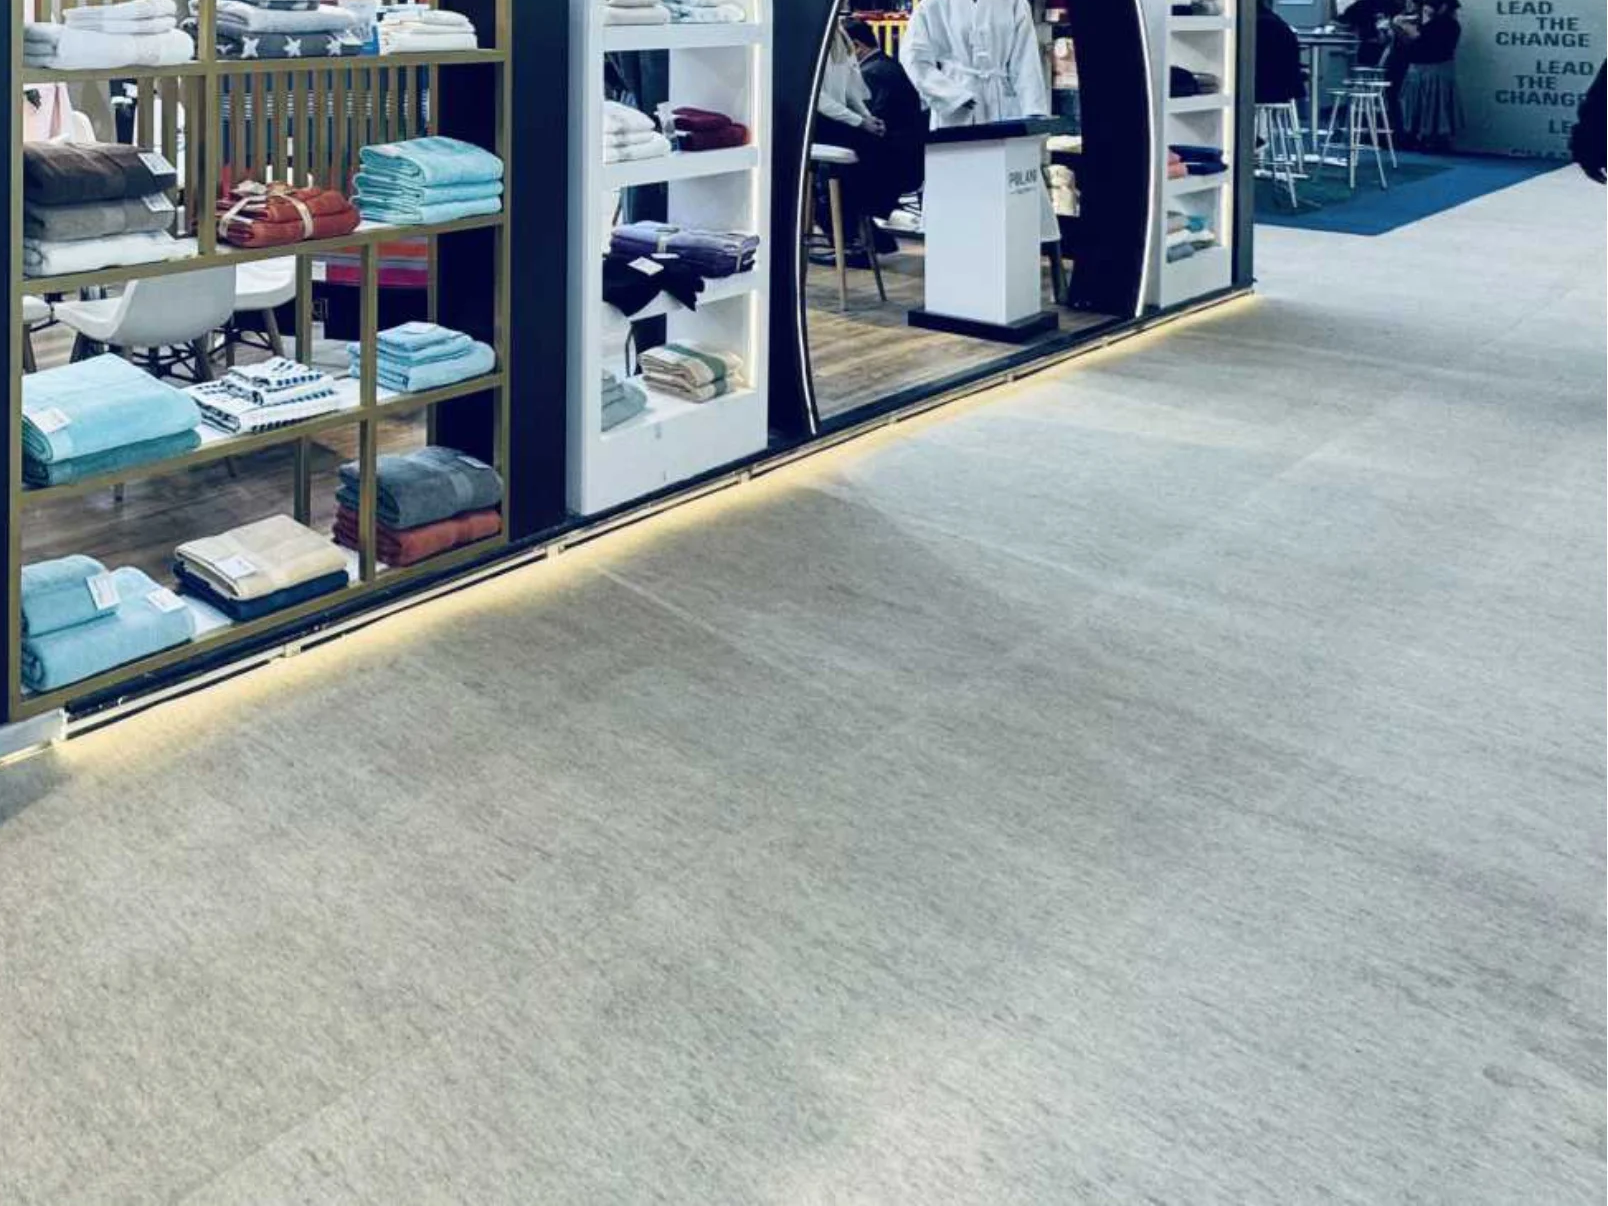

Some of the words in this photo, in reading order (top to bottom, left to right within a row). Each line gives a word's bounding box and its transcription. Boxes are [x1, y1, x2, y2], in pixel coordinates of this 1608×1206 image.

[1496, 0, 1553, 15] LEAD
[1535, 16, 1579, 31] THE
[1495, 32, 1591, 48] CHANGE
[1535, 59, 1594, 76] LEAD
[1514, 75, 1557, 90] THE
[1548, 118, 1572, 135] LE
